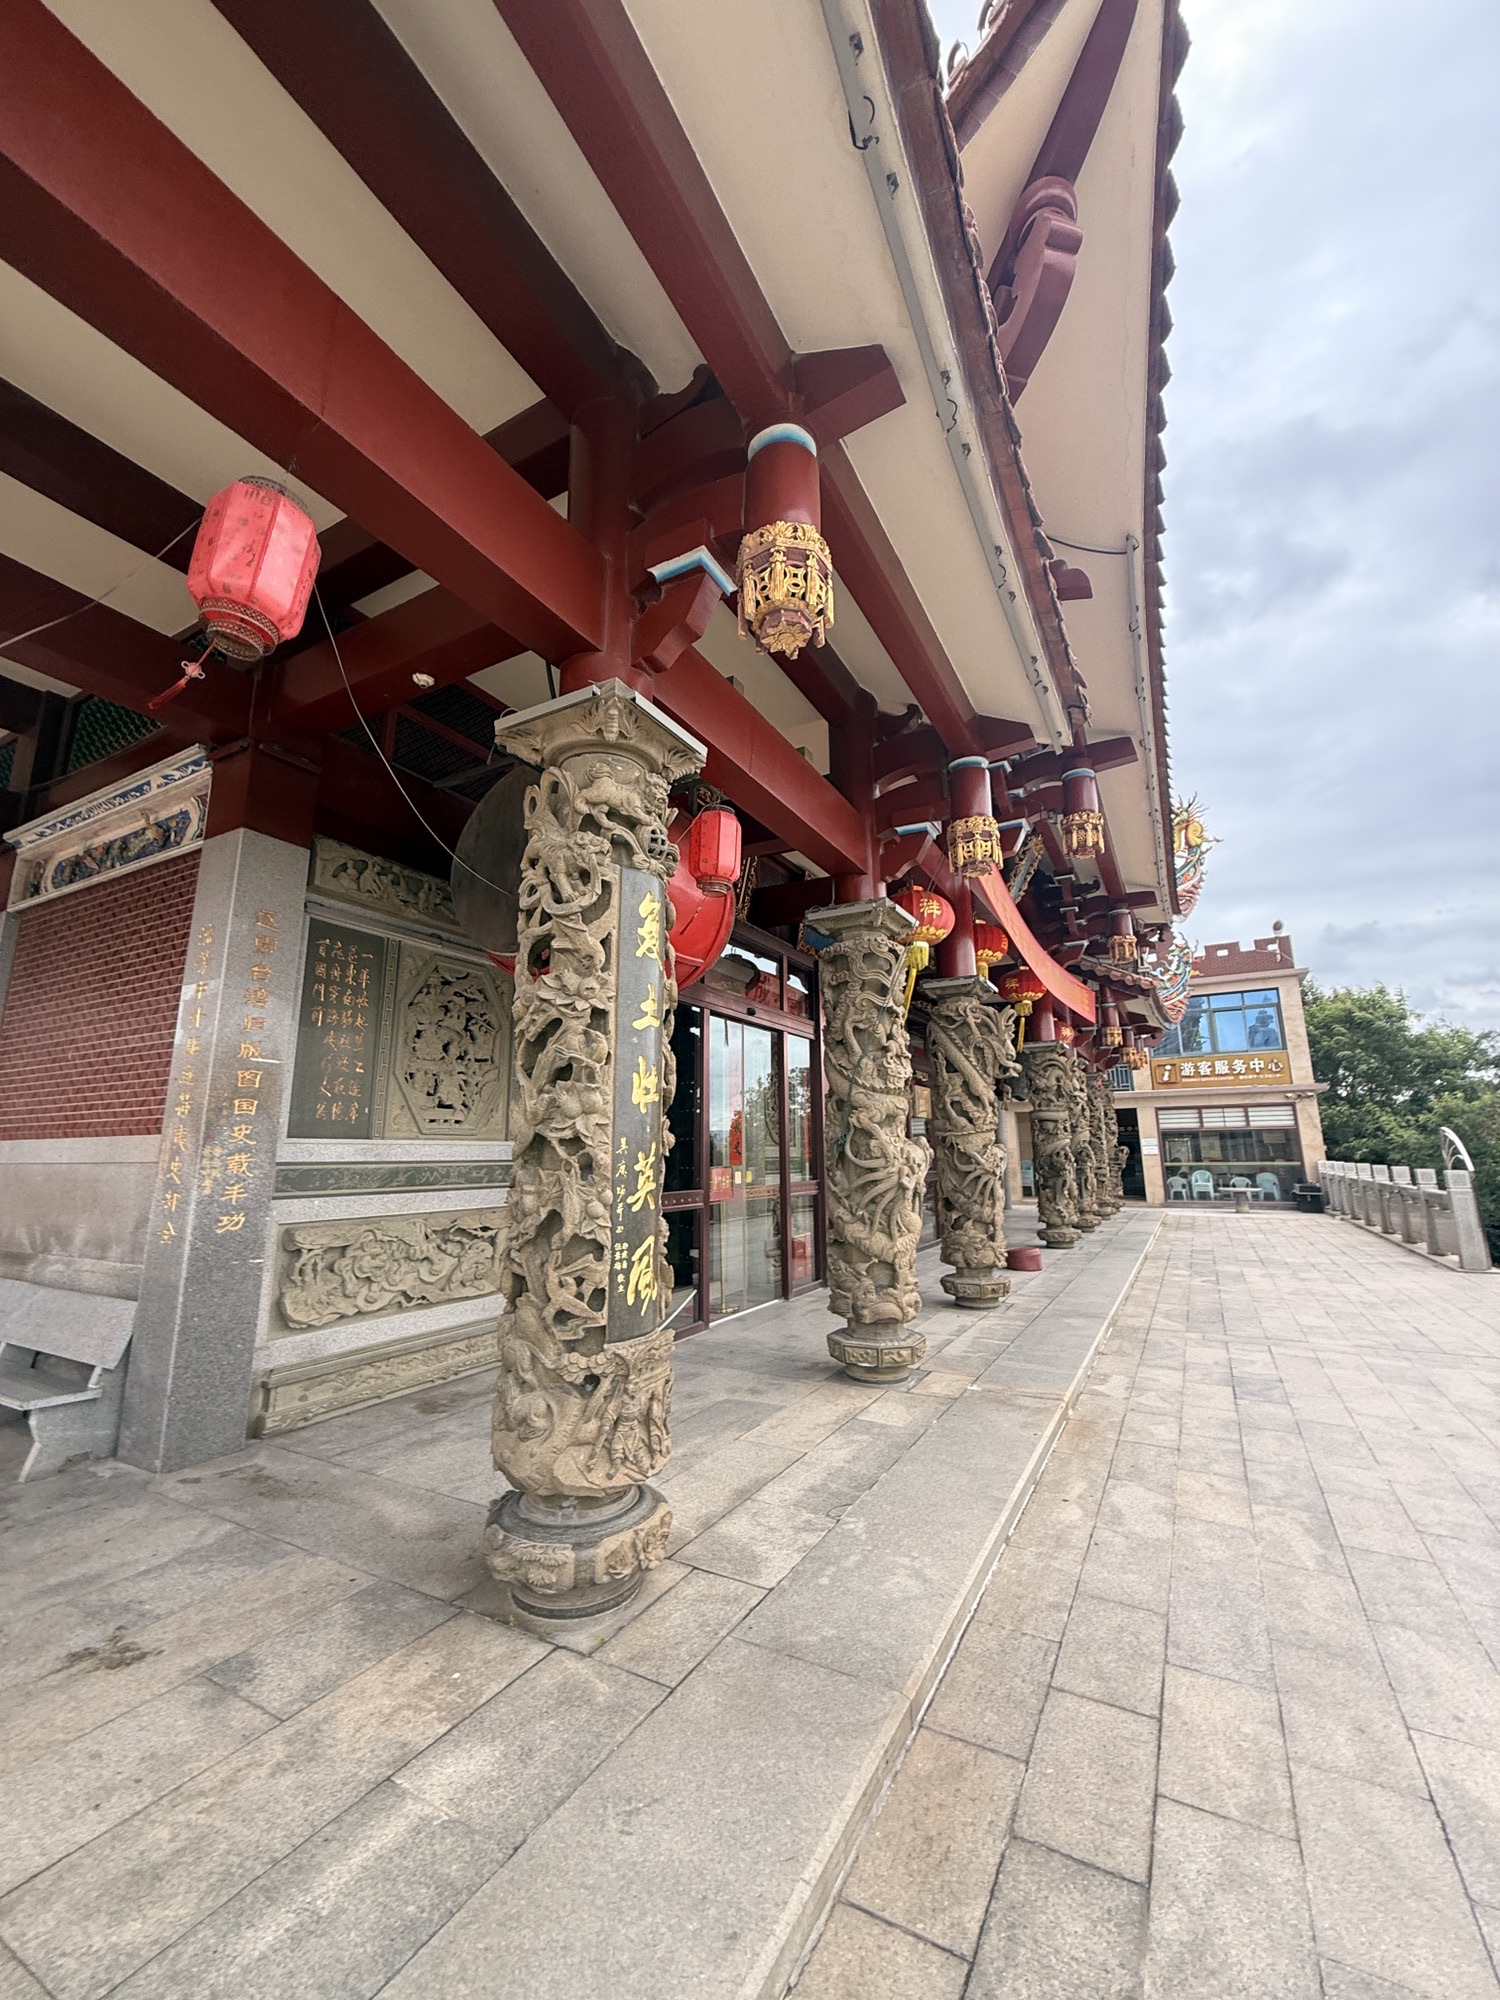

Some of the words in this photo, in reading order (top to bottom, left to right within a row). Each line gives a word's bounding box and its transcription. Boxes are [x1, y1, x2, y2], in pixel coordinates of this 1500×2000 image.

[919, 898, 943, 919] 祥
[1180, 1057, 1284, 1077] 游客服务中心
